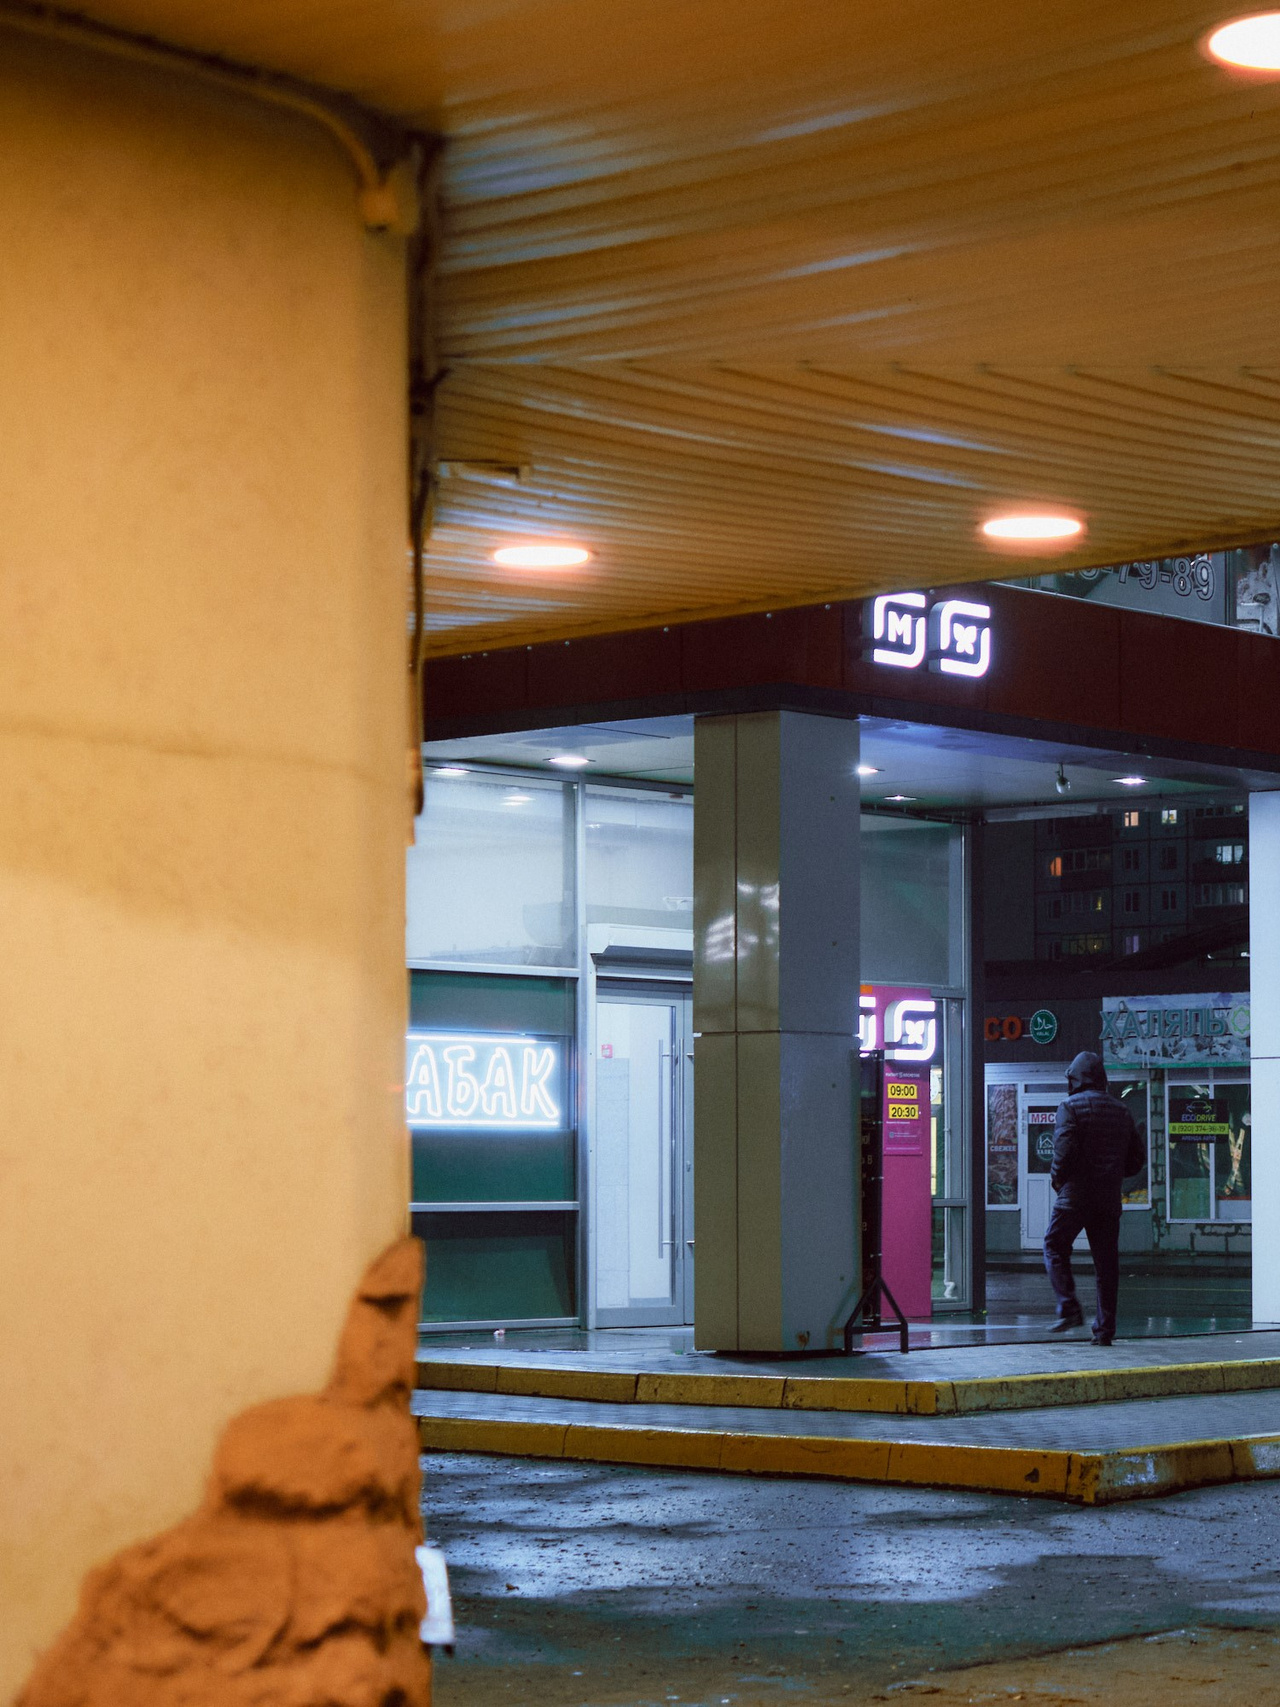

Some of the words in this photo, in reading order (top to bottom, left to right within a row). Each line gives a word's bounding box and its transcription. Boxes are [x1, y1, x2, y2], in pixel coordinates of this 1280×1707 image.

[1100, 1008, 1229, 1039] ХАЛЯЛЬ
[890, 1085, 915, 1096] 09:00
[891, 1107, 916, 1117] 20:30
